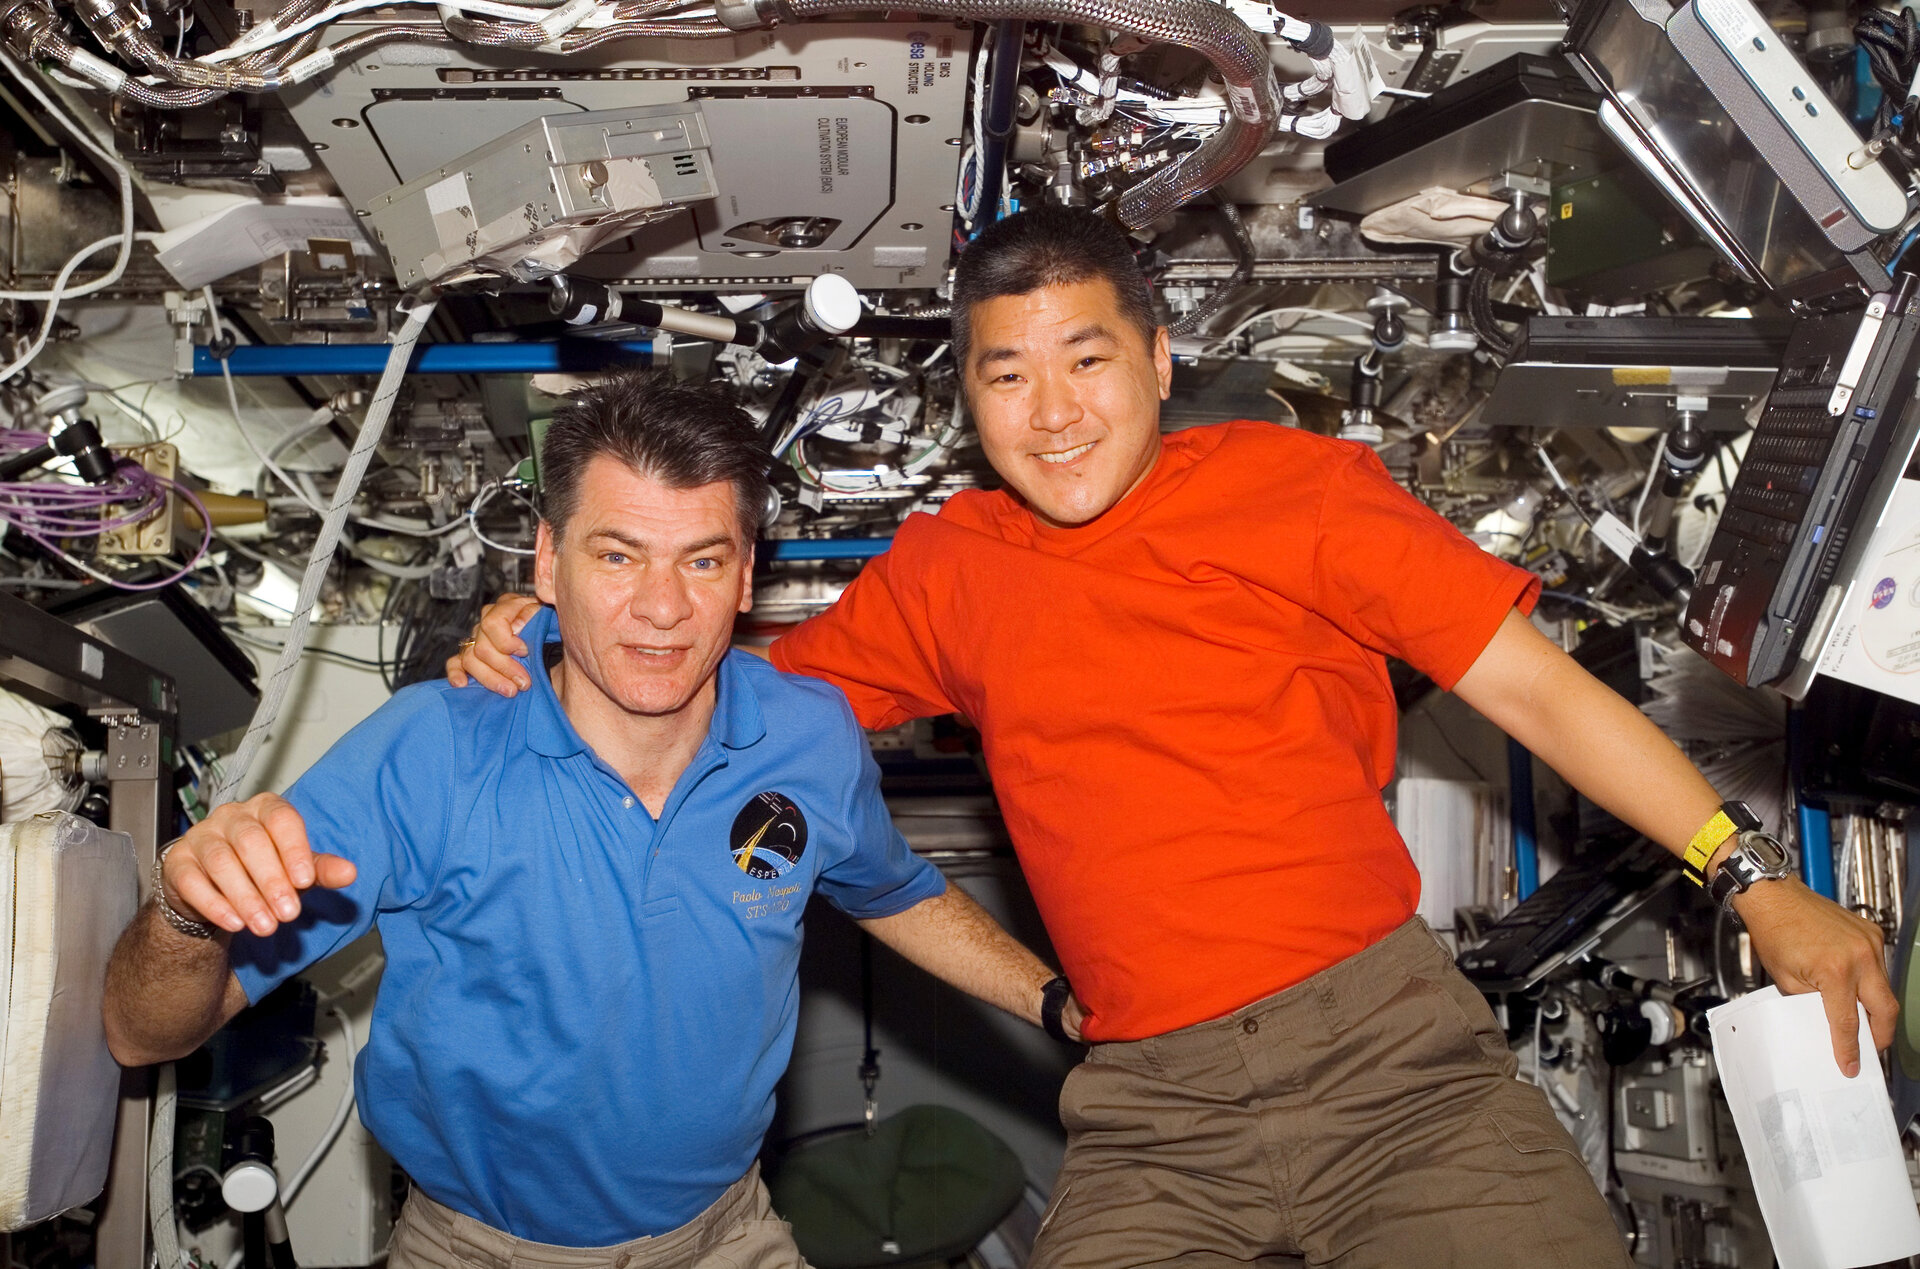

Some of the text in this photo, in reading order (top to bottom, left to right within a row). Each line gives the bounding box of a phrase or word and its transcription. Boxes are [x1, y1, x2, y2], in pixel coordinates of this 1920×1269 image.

[910, 42, 925, 59] esa
[907, 62, 919, 95] STRUCTURE
[923, 62, 935, 87] HOLDING
[939, 62, 951, 78] EMCS
[818, 117, 833, 193] CULTIVATION SYSTEM (EMCS)
[836, 117, 849, 176] EUROPEAN MODULAR
[732, 882, 802, 904] Paolo Nespoli
